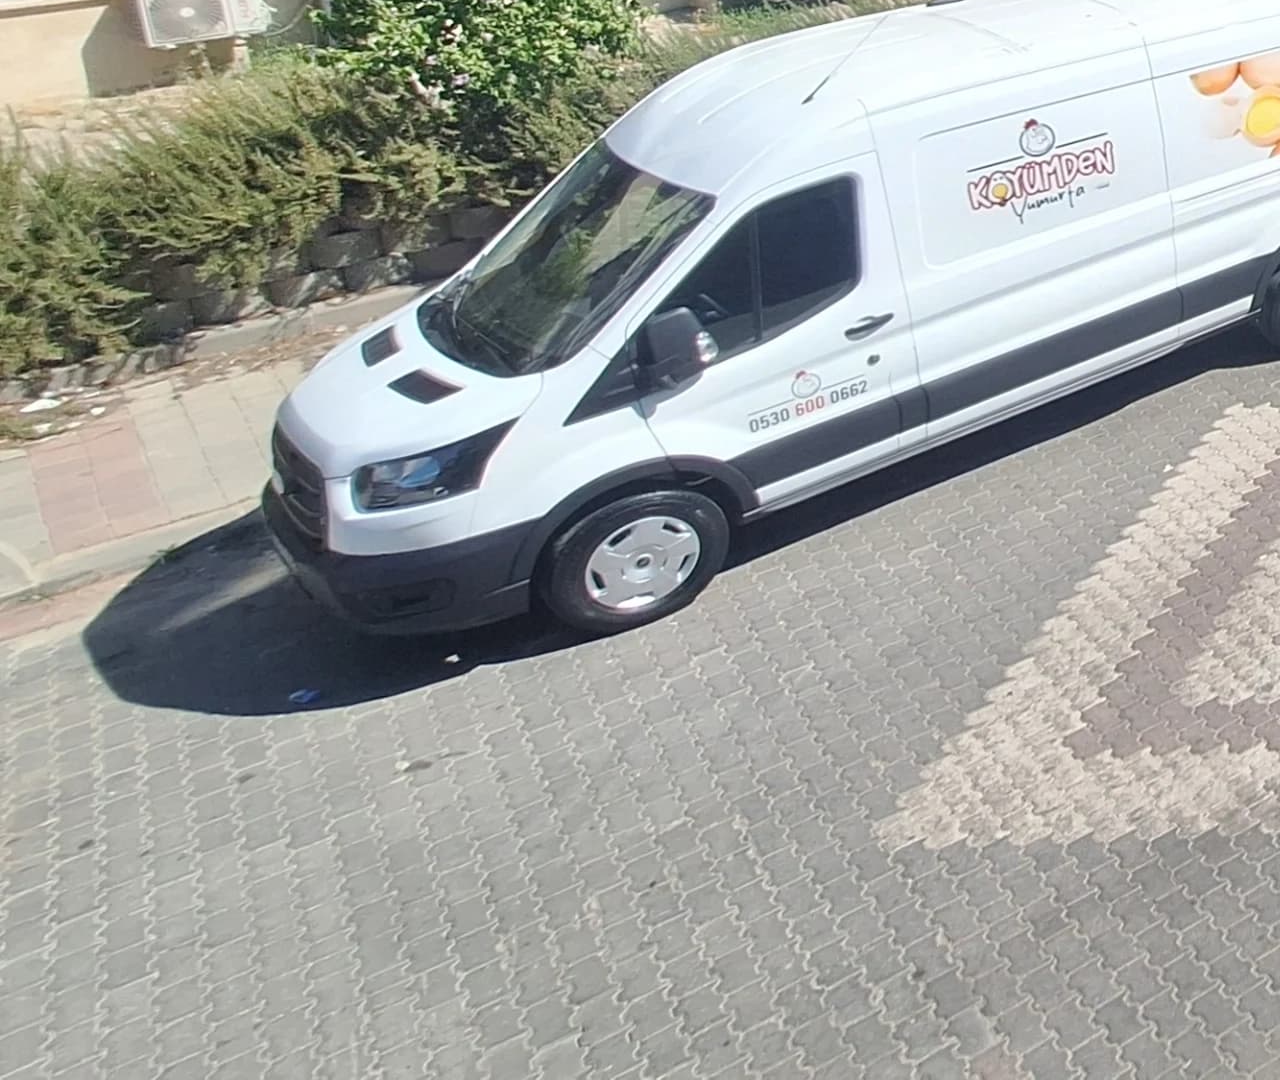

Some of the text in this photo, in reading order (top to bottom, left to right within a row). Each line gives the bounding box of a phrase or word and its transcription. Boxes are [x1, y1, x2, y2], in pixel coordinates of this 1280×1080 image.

[749, 380, 868, 433] 0530 600 0662
